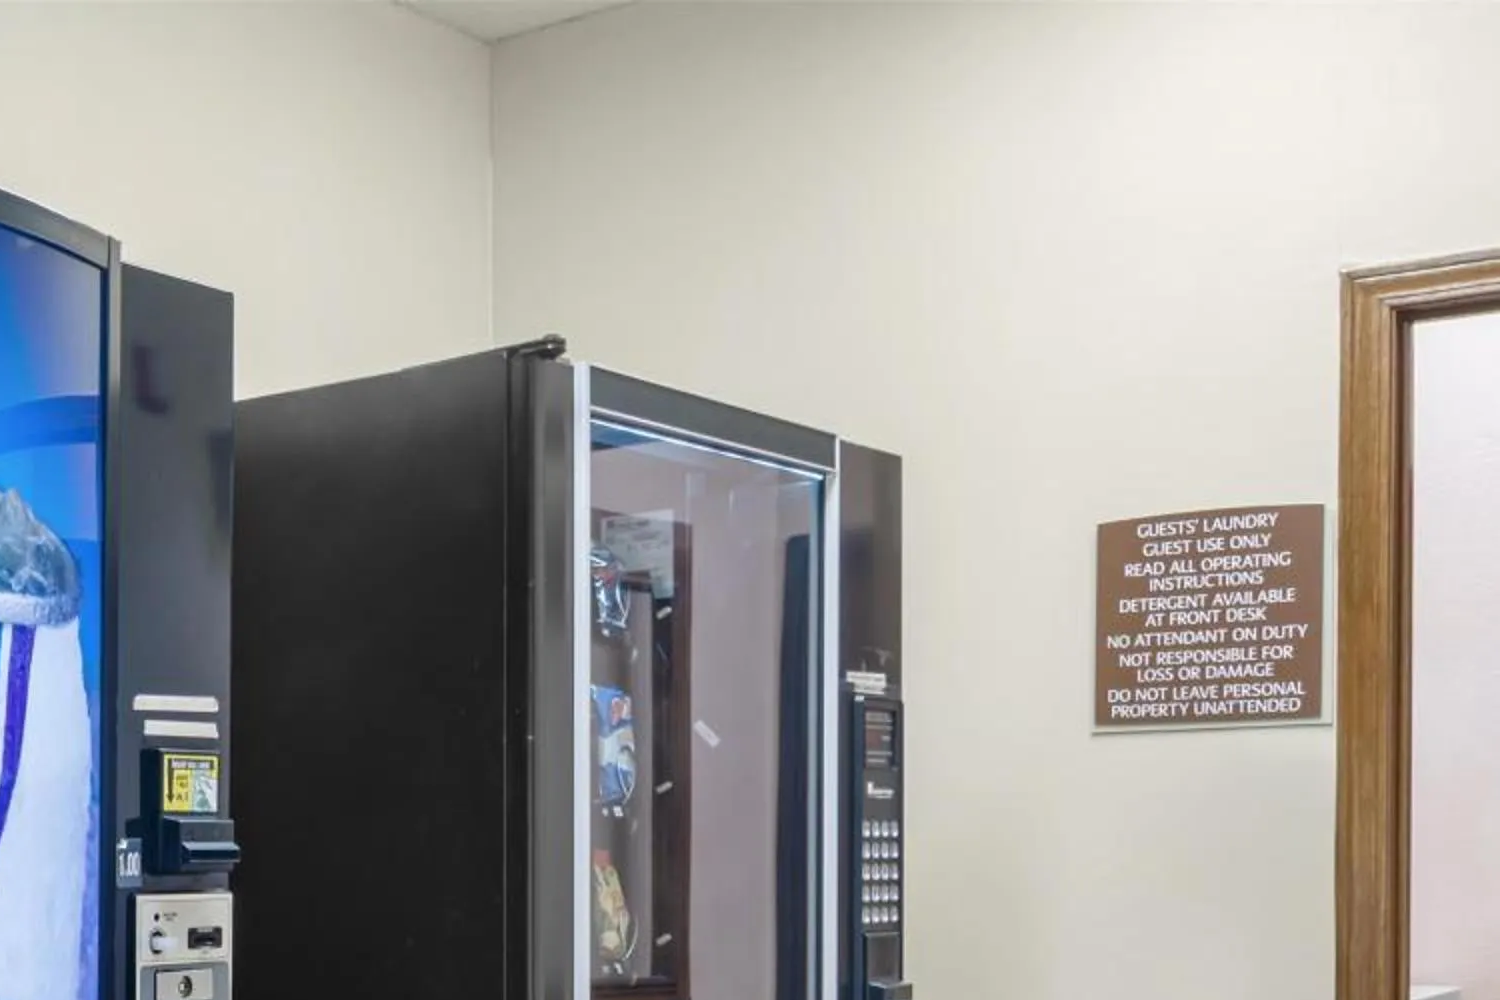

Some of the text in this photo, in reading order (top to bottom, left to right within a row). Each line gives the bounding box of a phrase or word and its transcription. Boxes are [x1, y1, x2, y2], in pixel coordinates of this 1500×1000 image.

[1203, 513, 1279, 532] LAUNDRY
[1143, 534, 1272, 557] GUEST USE ONLY
[1124, 552, 1292, 577] READ ALL OPERATING
[1149, 570, 1265, 592] INSTRUCTIONS
[1119, 588, 1296, 613] DETERGENT AVAILABLE
[1145, 607, 1267, 627] AT FRONT DESK
[1107, 623, 1308, 649] NO ATTENDANT ON DUTY
[1119, 645, 1294, 667] NOT RESPONSIBLE FOR
[1137, 662, 1275, 683] LOSS OR DAMAGE
[1107, 681, 1306, 703] DO NOT LEAVE PERSONAL
[1111, 697, 1301, 718] PROPERTY UNATTENDED
